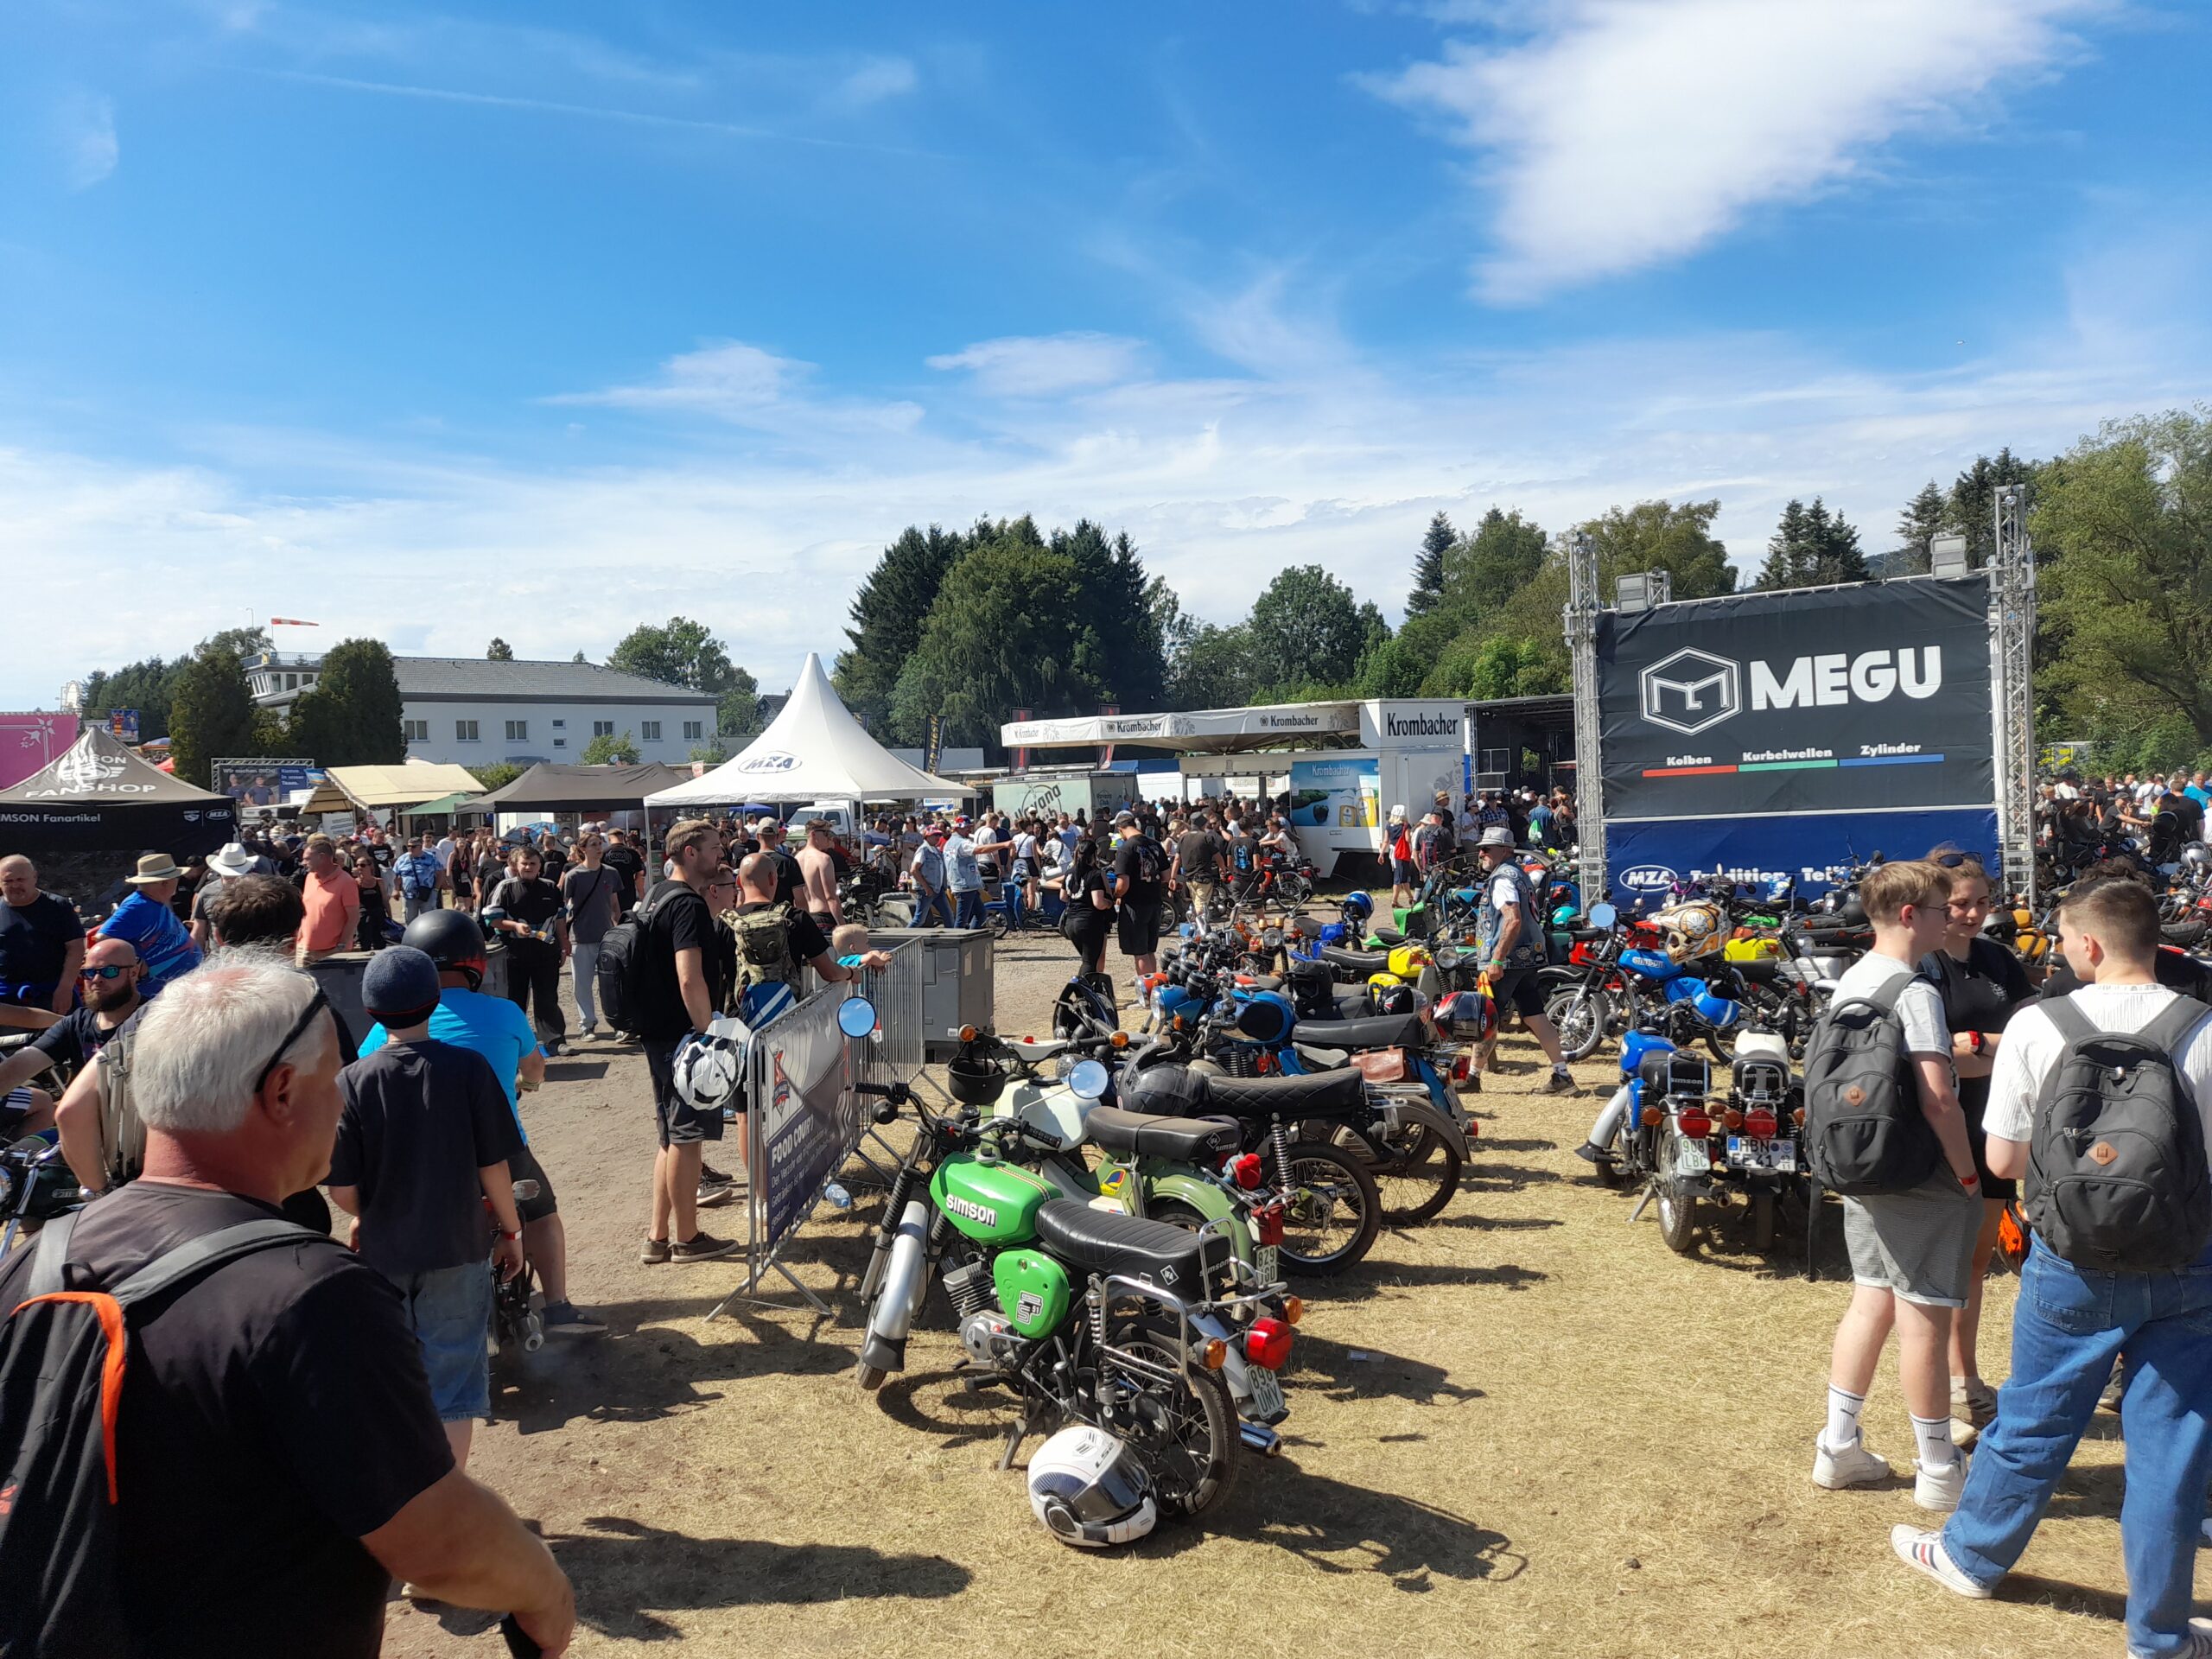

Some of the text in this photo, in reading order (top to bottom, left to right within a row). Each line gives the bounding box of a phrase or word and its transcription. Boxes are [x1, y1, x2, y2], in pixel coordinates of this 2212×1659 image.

[1750, 645, 1942, 710] MEGU
[1117, 721, 1161, 733] Krombacher
[1270, 715, 1319, 727] Krombacher
[1387, 712, 1459, 736] Krombacher
[1666, 743, 1922, 766] Kolben Kurbelwellen Zylinder
[1312, 764, 1351, 776] Krombacher
[25, 783, 156, 798] FANSHOP
[43, 813, 100, 822] Fanartikel
[1626, 870, 1670, 886] MZA
[1690, 868, 1786, 882] Tdition
[772, 1134, 793, 1168] FOOD
[1683, 1140, 1705, 1154] 908
[1739, 1139, 1770, 1152] HBN
[1685, 1154, 1707, 1168] LBC
[1732, 1154, 1773, 1166] EE 41
[1258, 1247, 1275, 1268] 829
[1258, 1384, 1281, 1413] UMY
